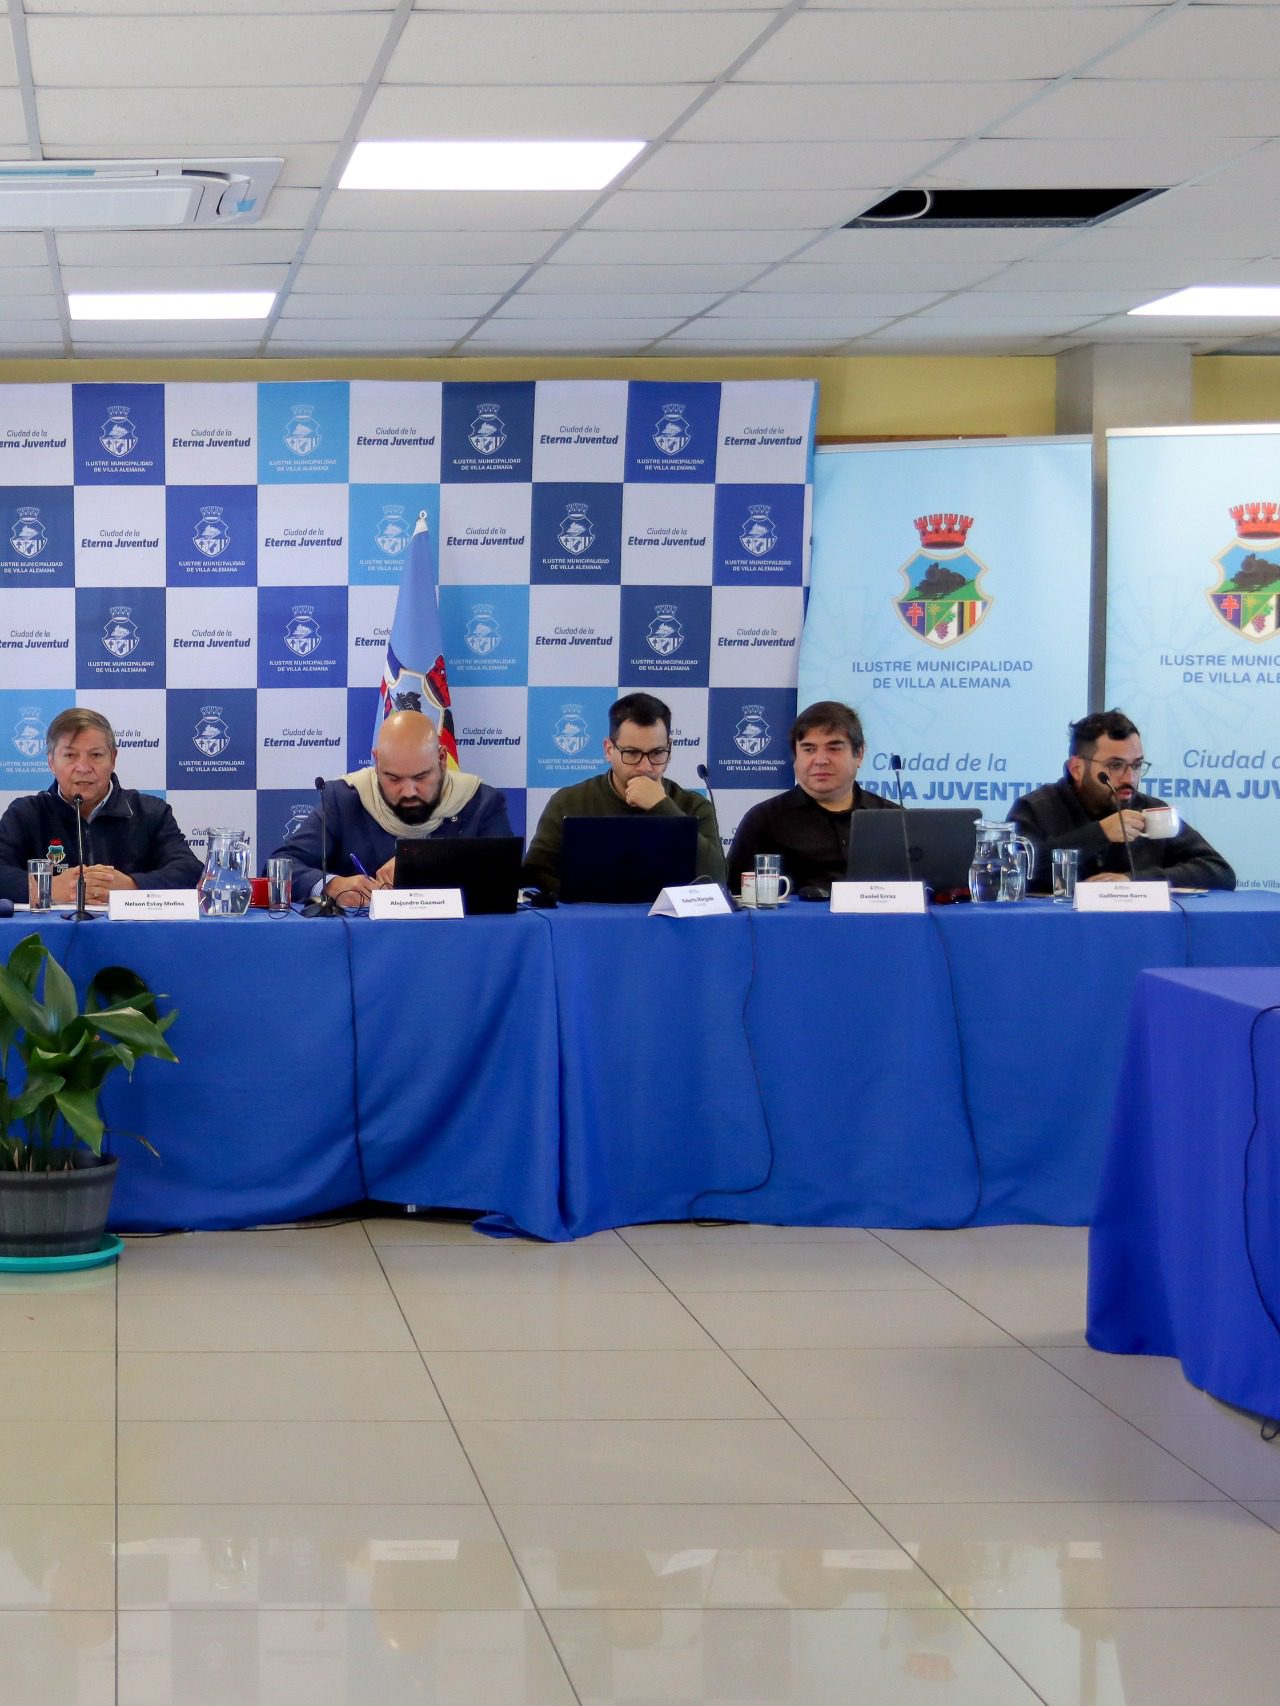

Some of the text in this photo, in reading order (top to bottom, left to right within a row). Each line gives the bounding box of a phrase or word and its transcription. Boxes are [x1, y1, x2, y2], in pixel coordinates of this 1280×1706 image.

[21, 438, 66, 448] Juventud
[172, 438, 250, 447] Eterna Juventud
[357, 436, 434, 446] Eterna Juventud
[540, 434, 618, 444] Eterna Juventud
[724, 436, 802, 445] Eterna Juventud
[81, 538, 159, 548] Eterna Juventud
[264, 537, 342, 547] Eterna Juventud
[447, 536, 524, 546] Eterna Juventud
[628, 536, 706, 546] Eterna Juventud
[24, 639, 69, 648] Juventud
[173, 638, 251, 648] Eterna Juventud
[355, 638, 386, 647] Eterna
[535, 636, 612, 646] Eterna Juventud
[717, 637, 795, 647] Eterna Juventud
[1160, 654, 1226, 666] ILUSTRE
[852, 660, 1033, 673] ILUSTRE MUNICIPALIDAD
[1183, 672, 1204, 683] DE
[1209, 672, 1251, 683] VILLA
[872, 677, 1011, 689] DE VILLA ALEMANA
[115, 738, 159, 748] Juventud
[263, 737, 341, 747] Eterna Juventud
[456, 736, 520, 746] erna Juventud
[672, 737, 700, 746] entud
[956, 753, 981, 771] de
[988, 753, 1007, 771] la
[1183, 749, 1266, 769] Ciudad
[1140, 778, 1231, 798] TERNA
